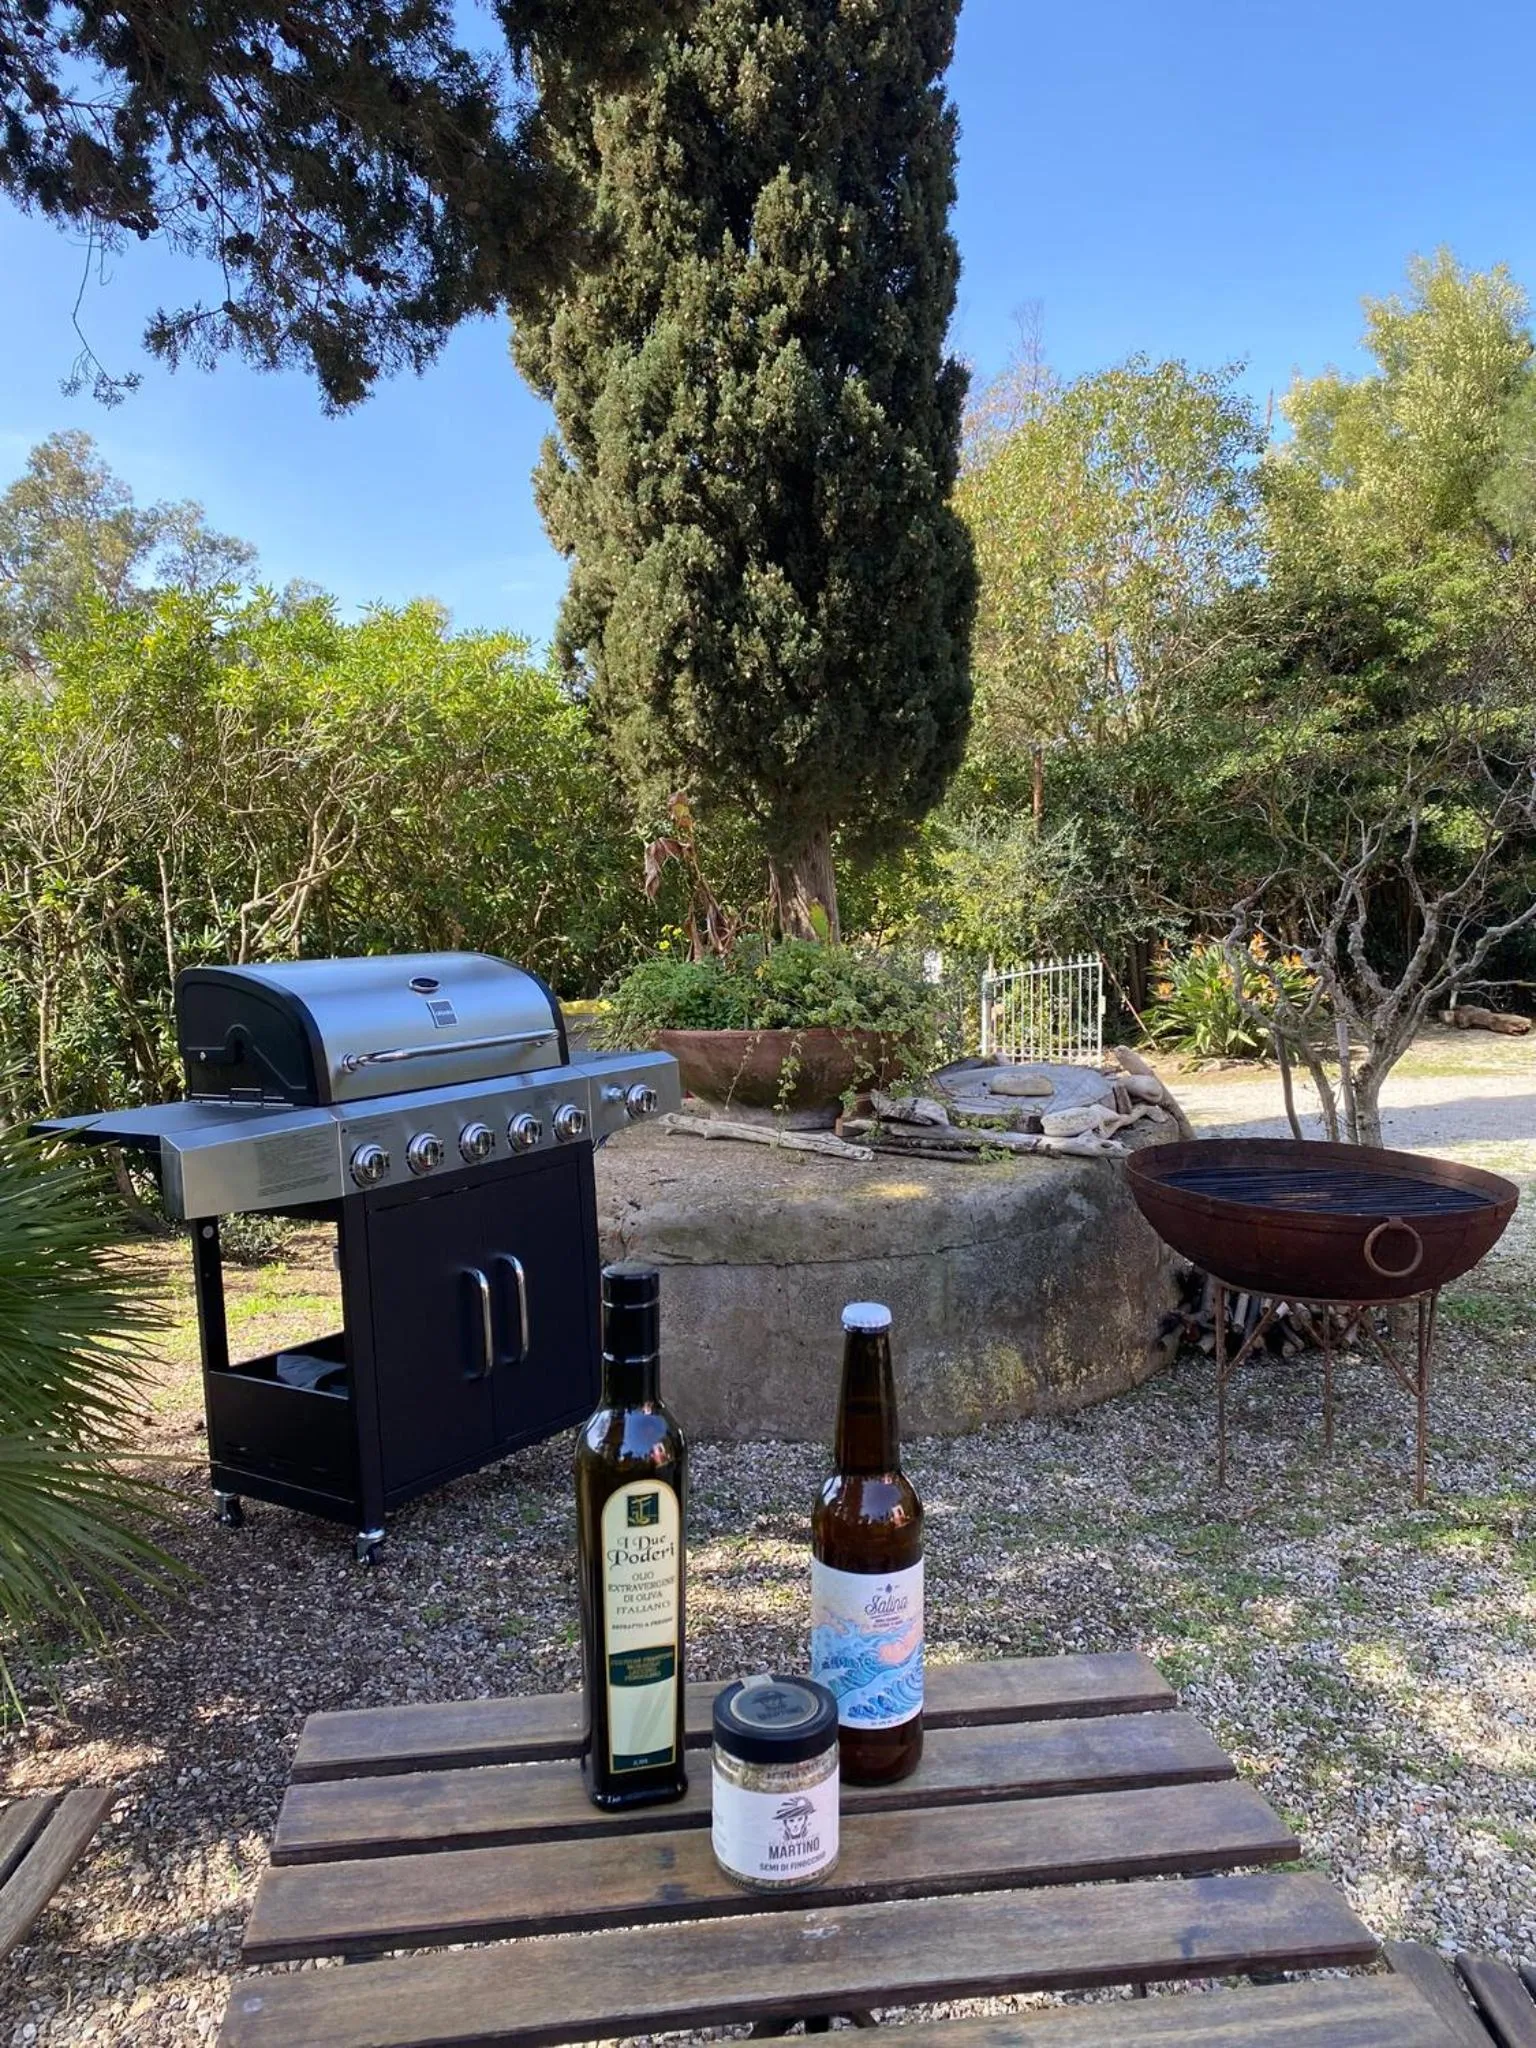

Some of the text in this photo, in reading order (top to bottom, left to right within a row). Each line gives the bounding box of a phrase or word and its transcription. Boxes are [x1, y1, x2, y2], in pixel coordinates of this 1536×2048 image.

[607, 1542, 675, 1571] Poderi
[631, 1571, 655, 1581] OLIO
[635, 1590, 663, 1602] OLIVA
[616, 1600, 671, 1615] ITALIANO
[768, 1837, 820, 1860] MARTINO
[759, 1862, 779, 1872] SEMI
[780, 1863, 789, 1872] DI
